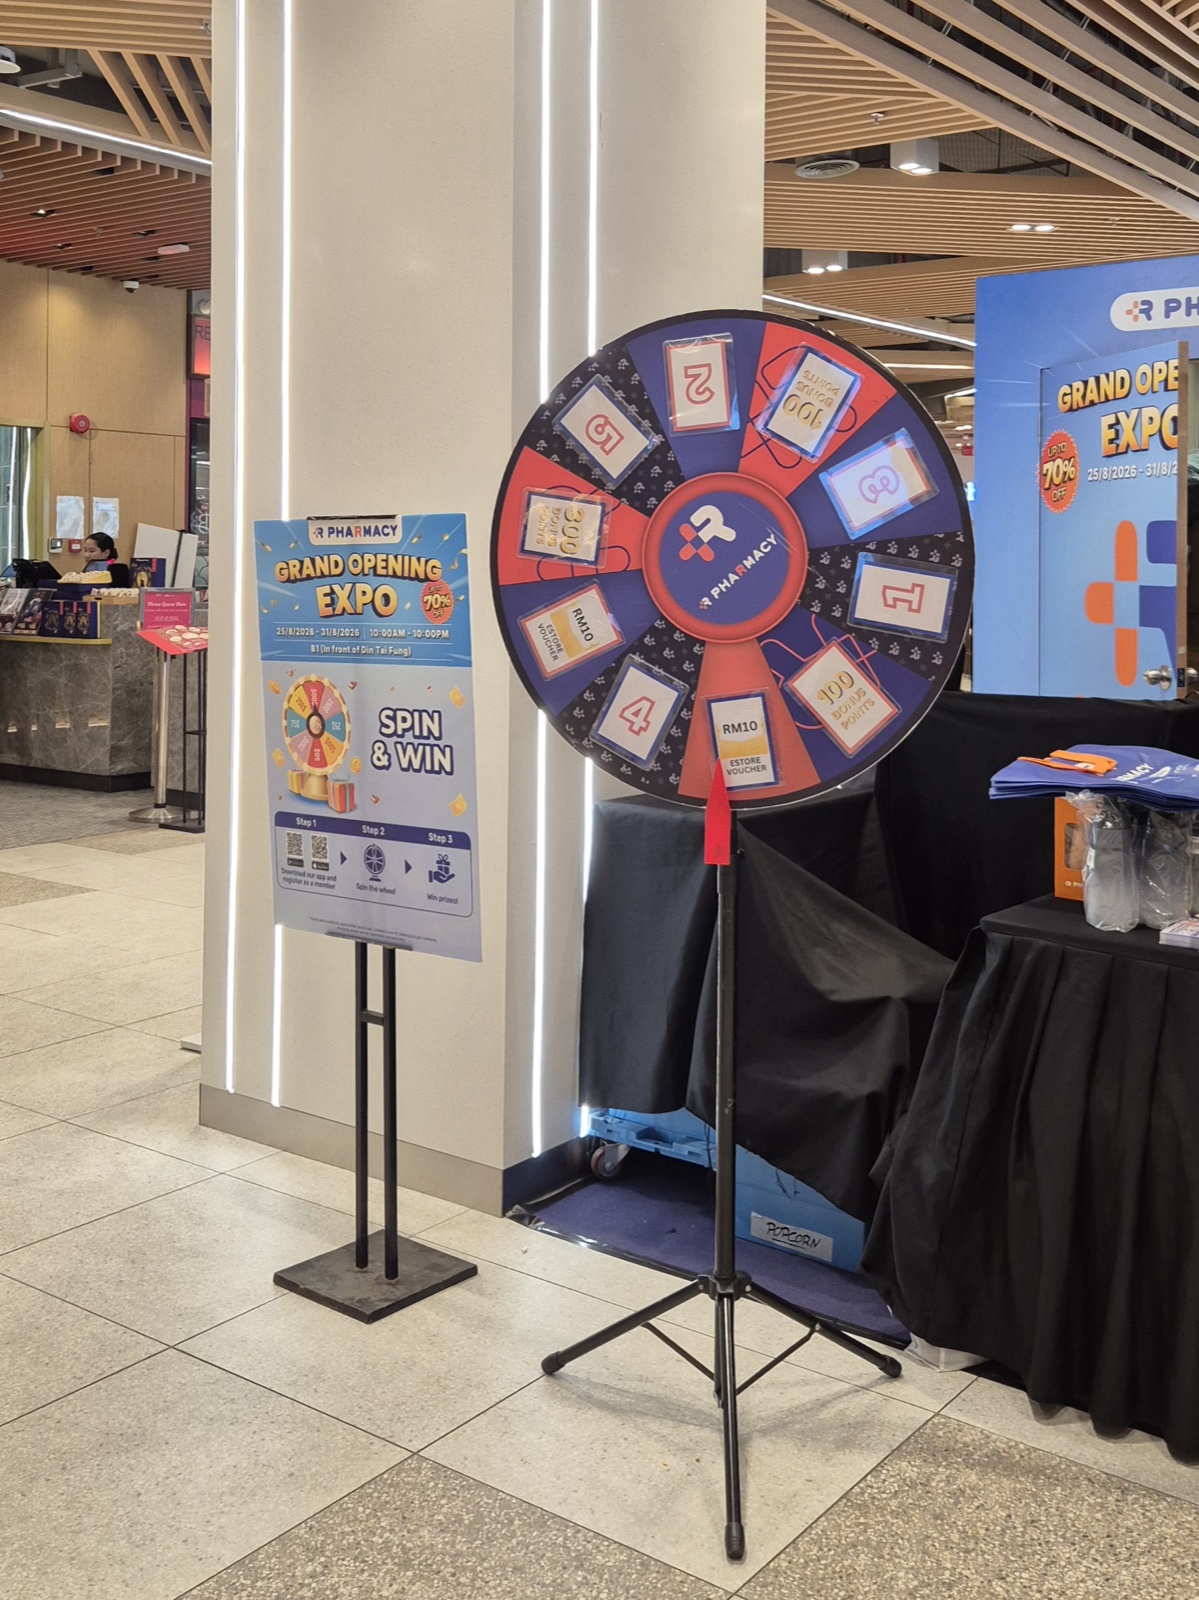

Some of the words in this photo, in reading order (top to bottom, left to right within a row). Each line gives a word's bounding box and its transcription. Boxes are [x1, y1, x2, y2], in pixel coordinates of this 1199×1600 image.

[1128, 299, 1153, 321] R
[683, 363, 715, 405] 2
[795, 381, 834, 409] BONUS
[802, 370, 840, 397] POINTS
[1057, 368, 1131, 412] GRAND
[783, 393, 825, 430] 100
[585, 413, 625, 456] 5
[1101, 403, 1179, 457] EXPO
[858, 465, 900, 504] 3
[1043, 456, 1076, 490] 70%
[1088, 465, 1137, 481] 25/8/2026
[1052, 487, 1066, 502] OFF
[328, 525, 397, 538] PHARMACY
[560, 505, 585, 555] 300
[275, 555, 344, 582] GRAND
[348, 553, 442, 582] OPENING
[710, 533, 777, 599] PHARMACY
[315, 583, 398, 618] EXPO
[424, 593, 451, 611] 70%
[881, 582, 925, 614] 1
[276, 627, 315, 637] 25/8/2026
[321, 627, 360, 637] 31/8/2026
[370, 628, 406, 638] 10:00AM
[413, 629, 449, 639] 10:00PM
[545, 624, 564, 654] ESTORE
[572, 608, 594, 642] RM10
[310, 644, 319, 653] B1
[332, 645, 351, 654] front
[352, 645, 360, 654] of
[361, 645, 374, 654] Din
[375, 646, 387, 655] Tai
[388, 646, 412, 658] Fung)
[538, 623, 558, 661] VOUCHER
[817, 670, 854, 705] 100
[618, 695, 655, 736] 4
[831, 687, 867, 720] BONUS
[841, 698, 875, 730] POINTS
[379, 707, 442, 740] SPIN
[722, 720, 758, 734] RM10
[371, 739, 391, 770] &
[395, 741, 453, 775] WIN
[726, 764, 767, 775] VOUCHER
[730, 756, 761, 767] ESTORE
[295, 817, 312, 827] Step
[313, 819, 317, 827] 1
[361, 825, 380, 836] Step
[380, 827, 386, 835] 2
[428, 832, 447, 844] Step
[447, 835, 453, 843] 3
[356, 882, 368, 891] Spin
[369, 884, 378, 892] the
[766, 1222, 822, 1248] POPCORN
